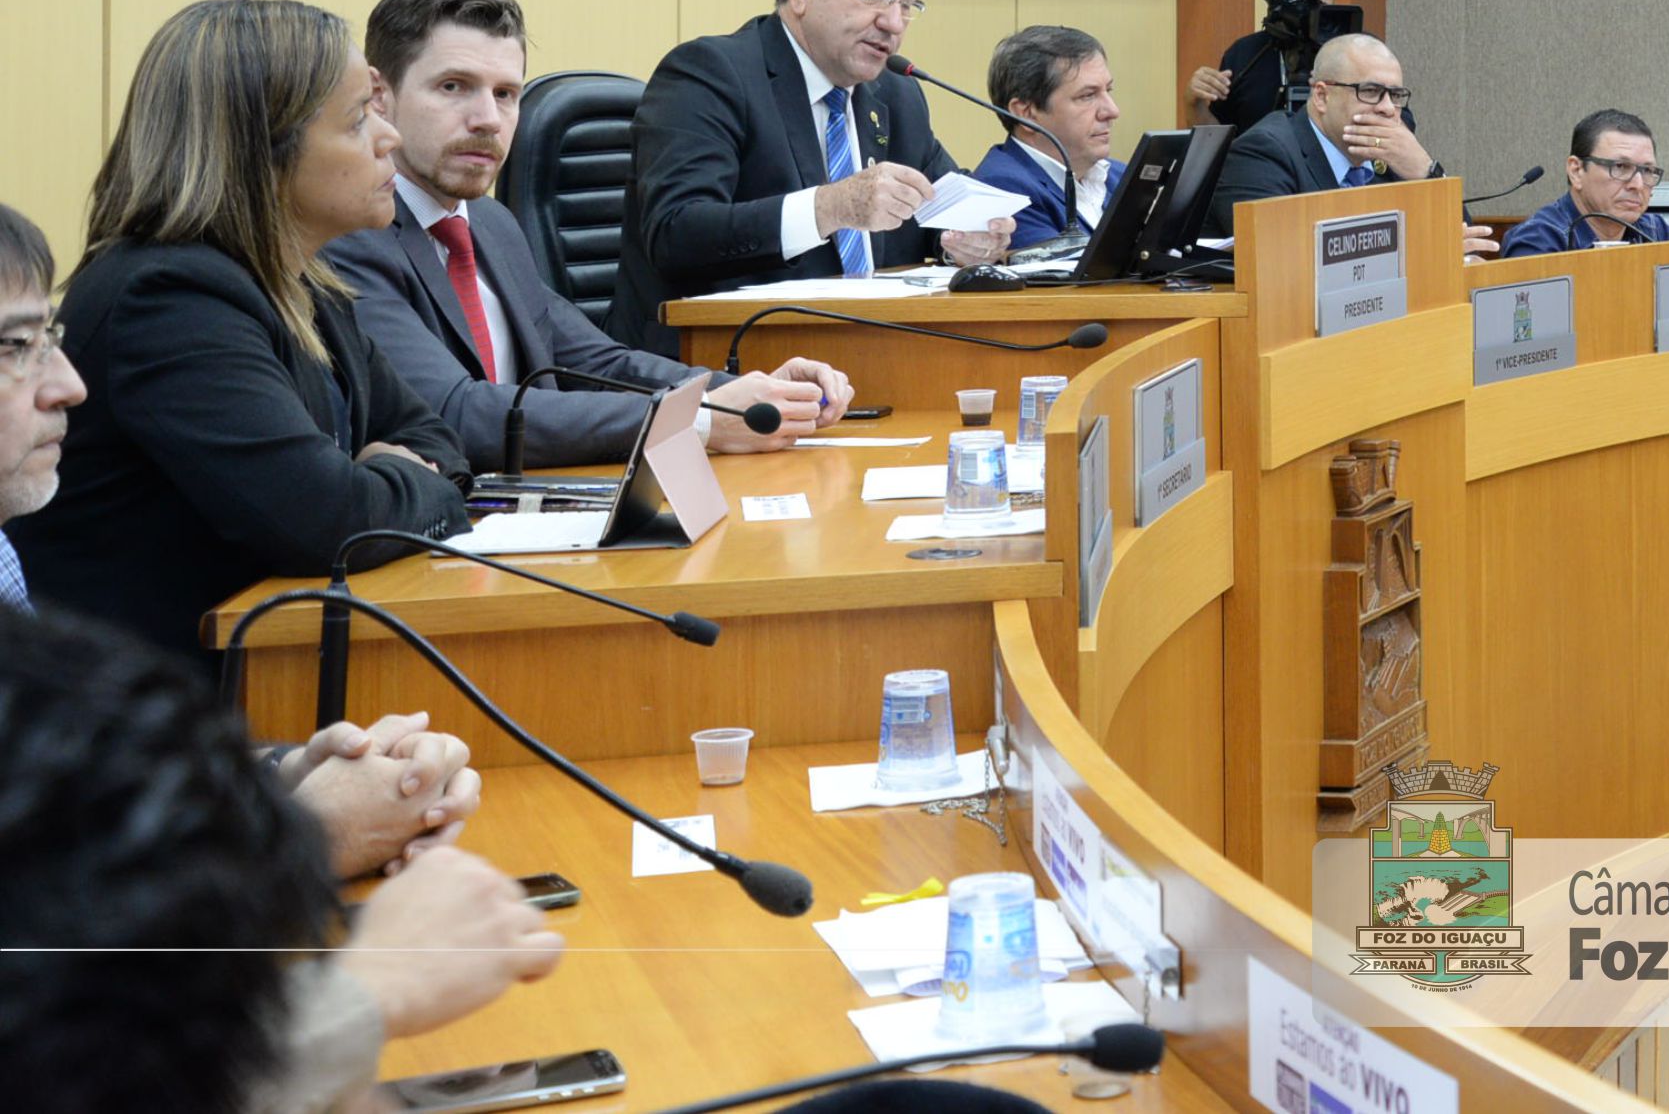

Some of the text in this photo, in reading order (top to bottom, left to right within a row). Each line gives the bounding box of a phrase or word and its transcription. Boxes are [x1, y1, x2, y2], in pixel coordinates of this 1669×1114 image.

[1327, 227, 1392, 258] CELINO FERTRIN
[1352, 264, 1366, 282] PDT
[1344, 296, 1384, 319] PRESIDENTE
[1502, 348, 1558, 369] VICE-PRESIDENTE
[1280, 1007, 1335, 1077] Estamos
[1340, 1055, 1356, 1091] ao
[1360, 1062, 1411, 1114] VIVO
